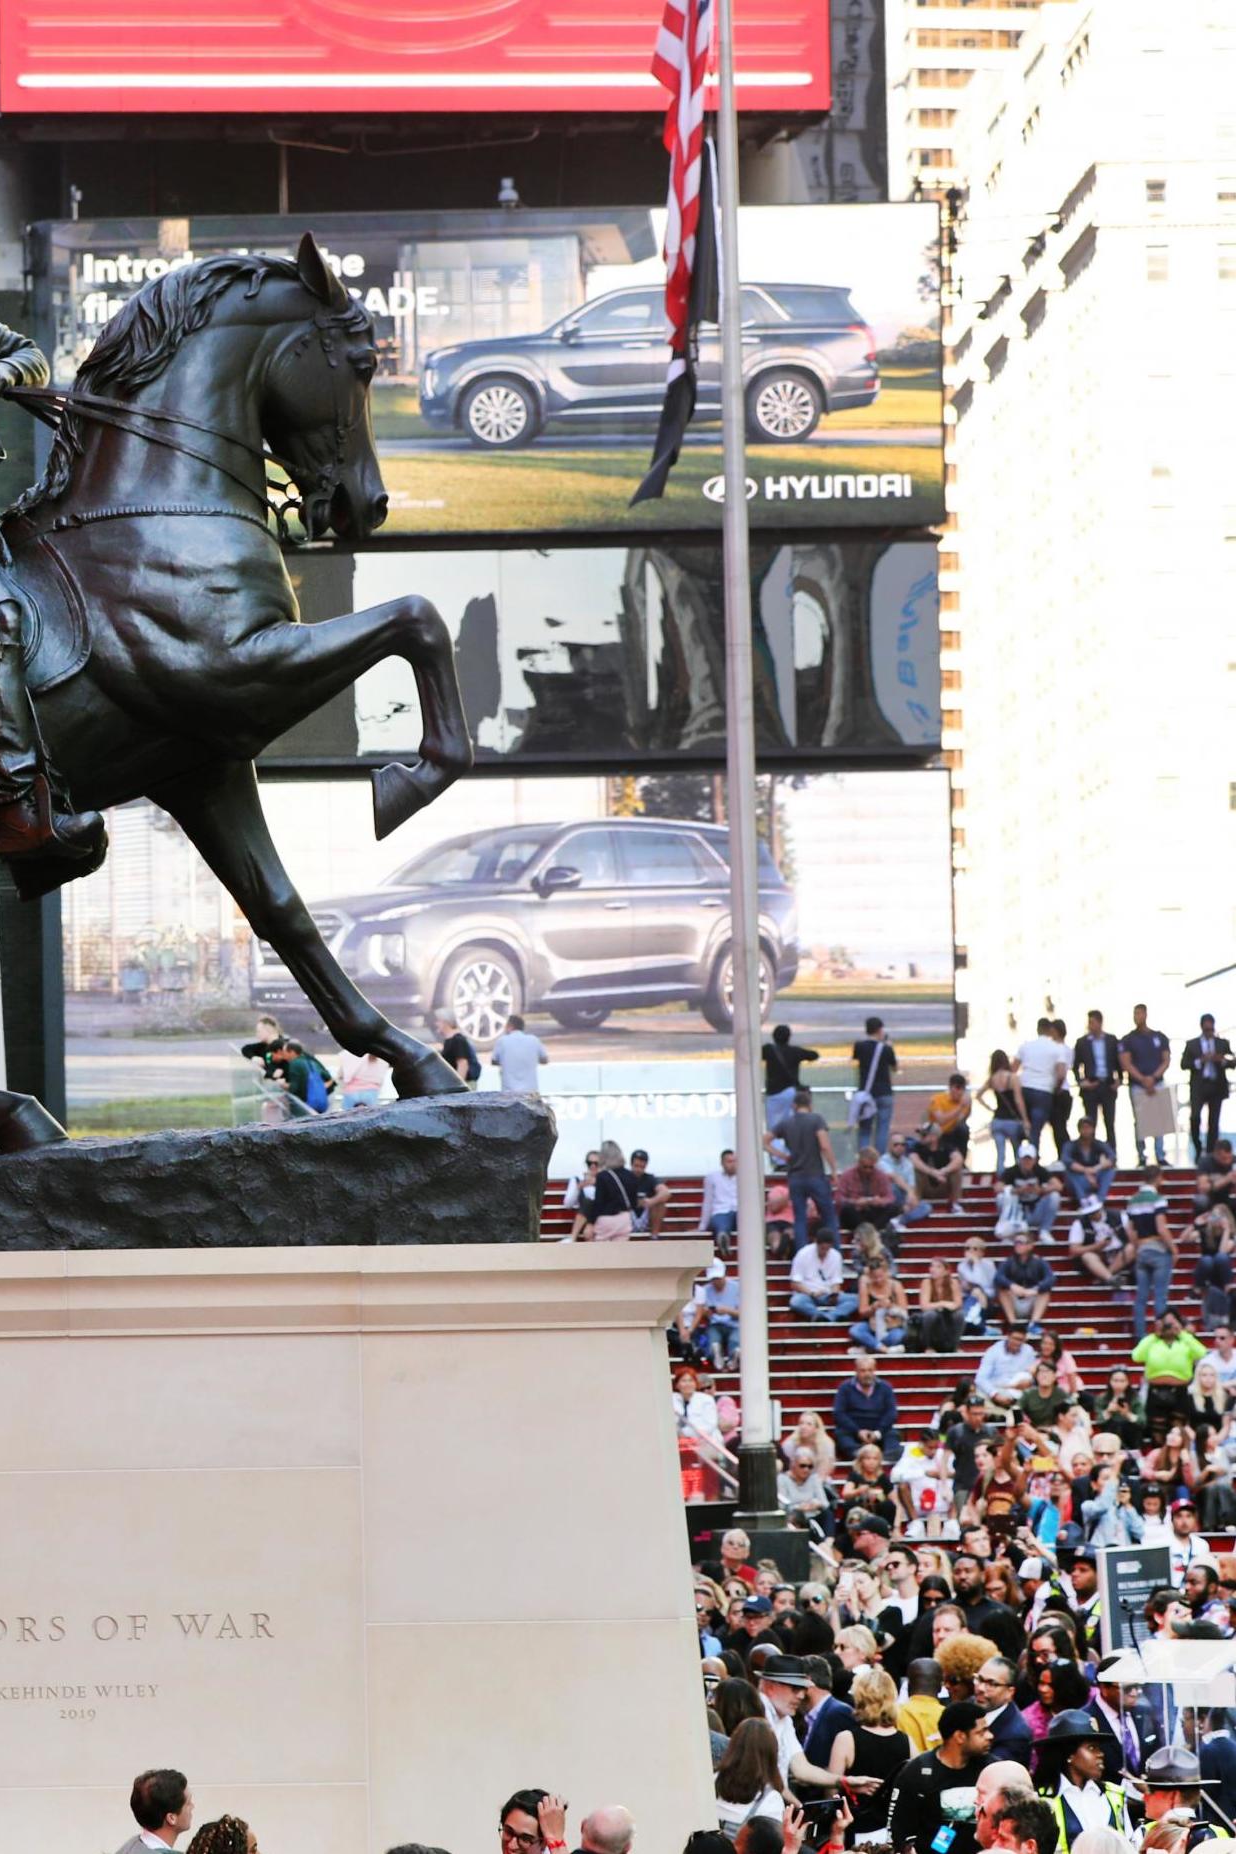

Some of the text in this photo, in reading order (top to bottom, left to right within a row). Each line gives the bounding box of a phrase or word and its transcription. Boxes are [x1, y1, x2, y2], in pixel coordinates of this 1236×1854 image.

[325, 251, 365, 278] he
[765, 474, 912, 500] HYUNDAI
[92, 1614, 150, 1641] OF
[173, 1612, 275, 1640] WAR
[95, 1684, 159, 1699] WILEY
[59, 1708, 97, 1721] 2019
